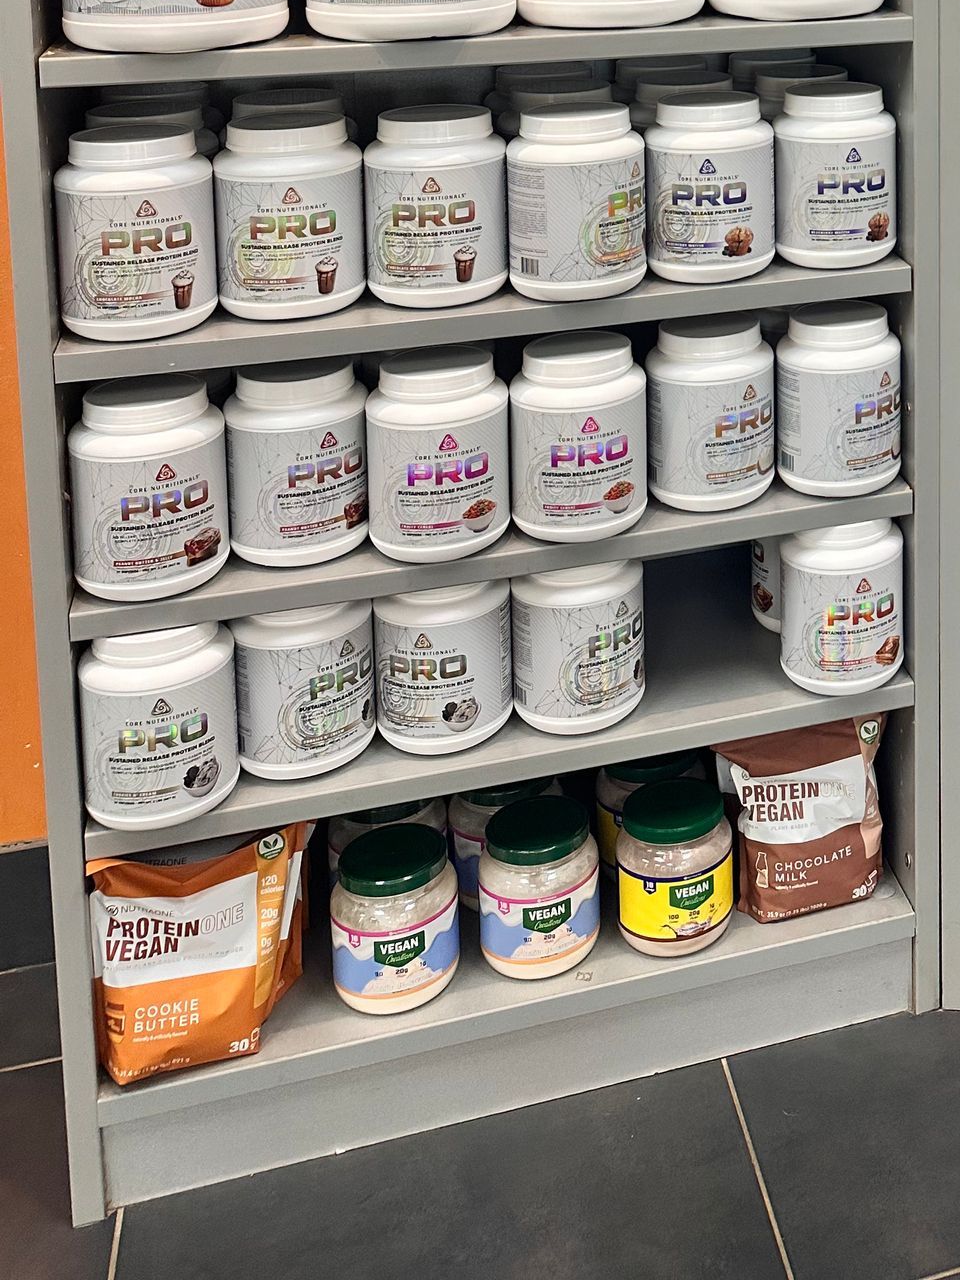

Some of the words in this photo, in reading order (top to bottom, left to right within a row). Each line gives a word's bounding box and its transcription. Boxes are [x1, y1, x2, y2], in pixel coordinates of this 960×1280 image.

[671, 182, 747, 207] PRO
[817, 169, 886, 195] PRO
[250, 209, 337, 240] PRO
[392, 200, 475, 227] PRO
[101, 222, 192, 256] PRO
[715, 399, 772, 438] PRO
[551, 434, 628, 467] PRO
[287, 446, 363, 488] PRO
[407, 452, 489, 486] PRO
[120, 480, 209, 521] PRO
[828, 593, 894, 626] PRO
[588, 616, 643, 659] PRO
[310, 649, 372, 700] PRO
[390, 654, 467, 681] PRO
[118, 712, 209, 754] PRO
[742, 782, 855, 805] PROTEINONE
[749, 803, 804, 822] VEGAN
[775, 845, 852, 872] CHOCOLATE
[261, 875, 278, 887] 120
[776, 870, 807, 882] MILK
[674, 881, 710, 898] VEGAN
[852, 884, 867, 899] 30
[106, 902, 244, 939] PROTEINONE
[121, 904, 173, 918] NUTRAONE
[261, 908, 278, 919] 20g
[528, 904, 566, 921] VEGAN
[105, 936, 179, 962] VEGAN
[379, 937, 419, 955] VEGAN
[134, 998, 199, 1020] COOKIE
[134, 1013, 200, 1034] BUTTER
[229, 1038, 249, 1053] 30
